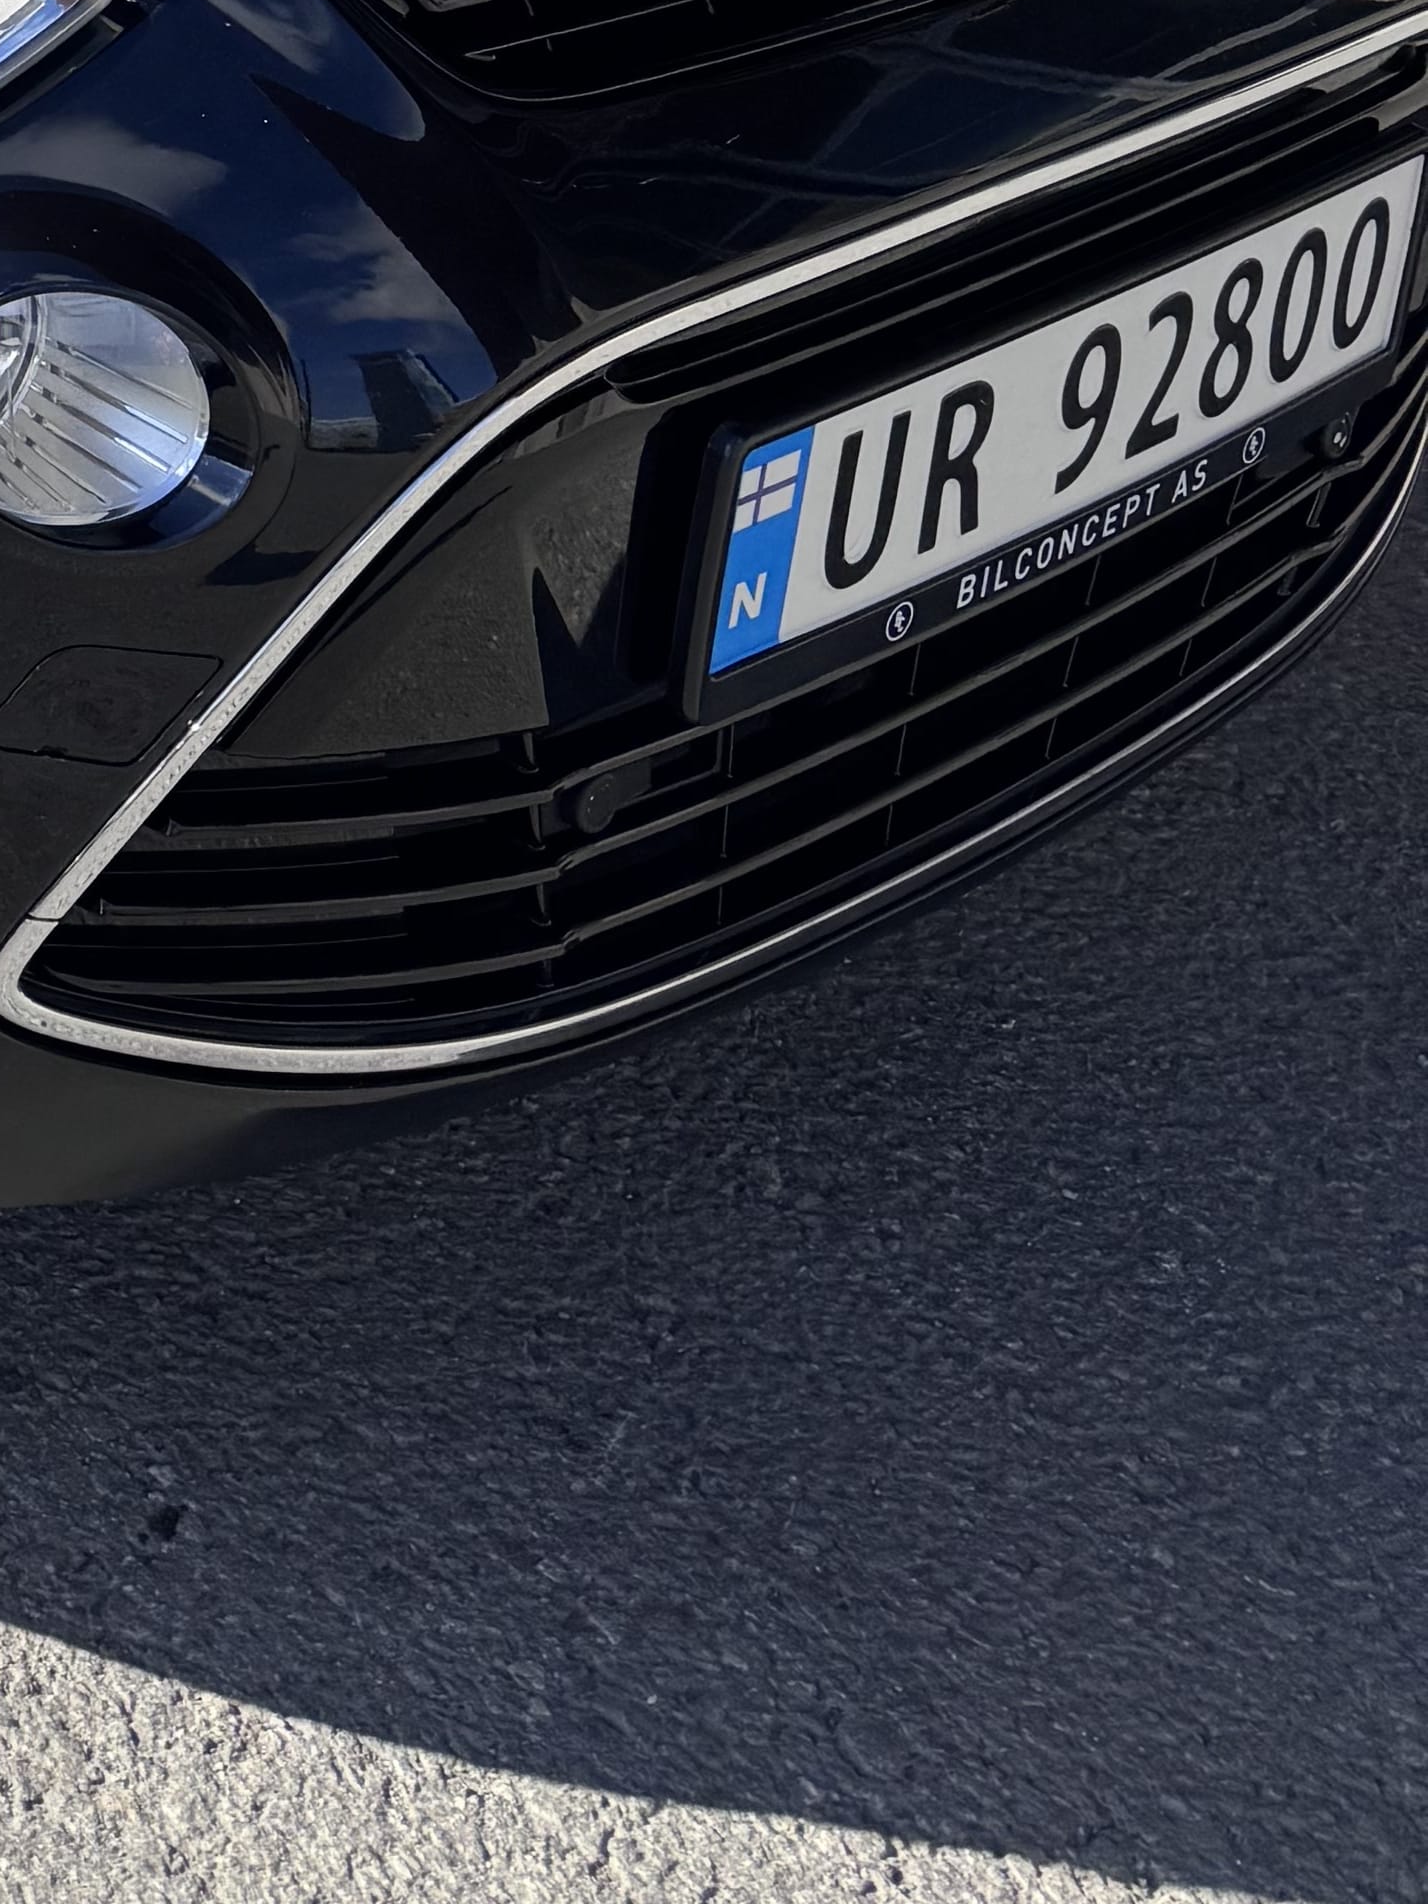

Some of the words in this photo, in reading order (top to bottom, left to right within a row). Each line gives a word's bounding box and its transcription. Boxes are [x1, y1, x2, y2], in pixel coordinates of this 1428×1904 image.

[823, 379, 995, 590] UR
[1054, 196, 1391, 495] 92800
[728, 572, 765, 629] N
[956, 483, 1163, 610] BILCONCEPT
[1171, 459, 1209, 504] AS
